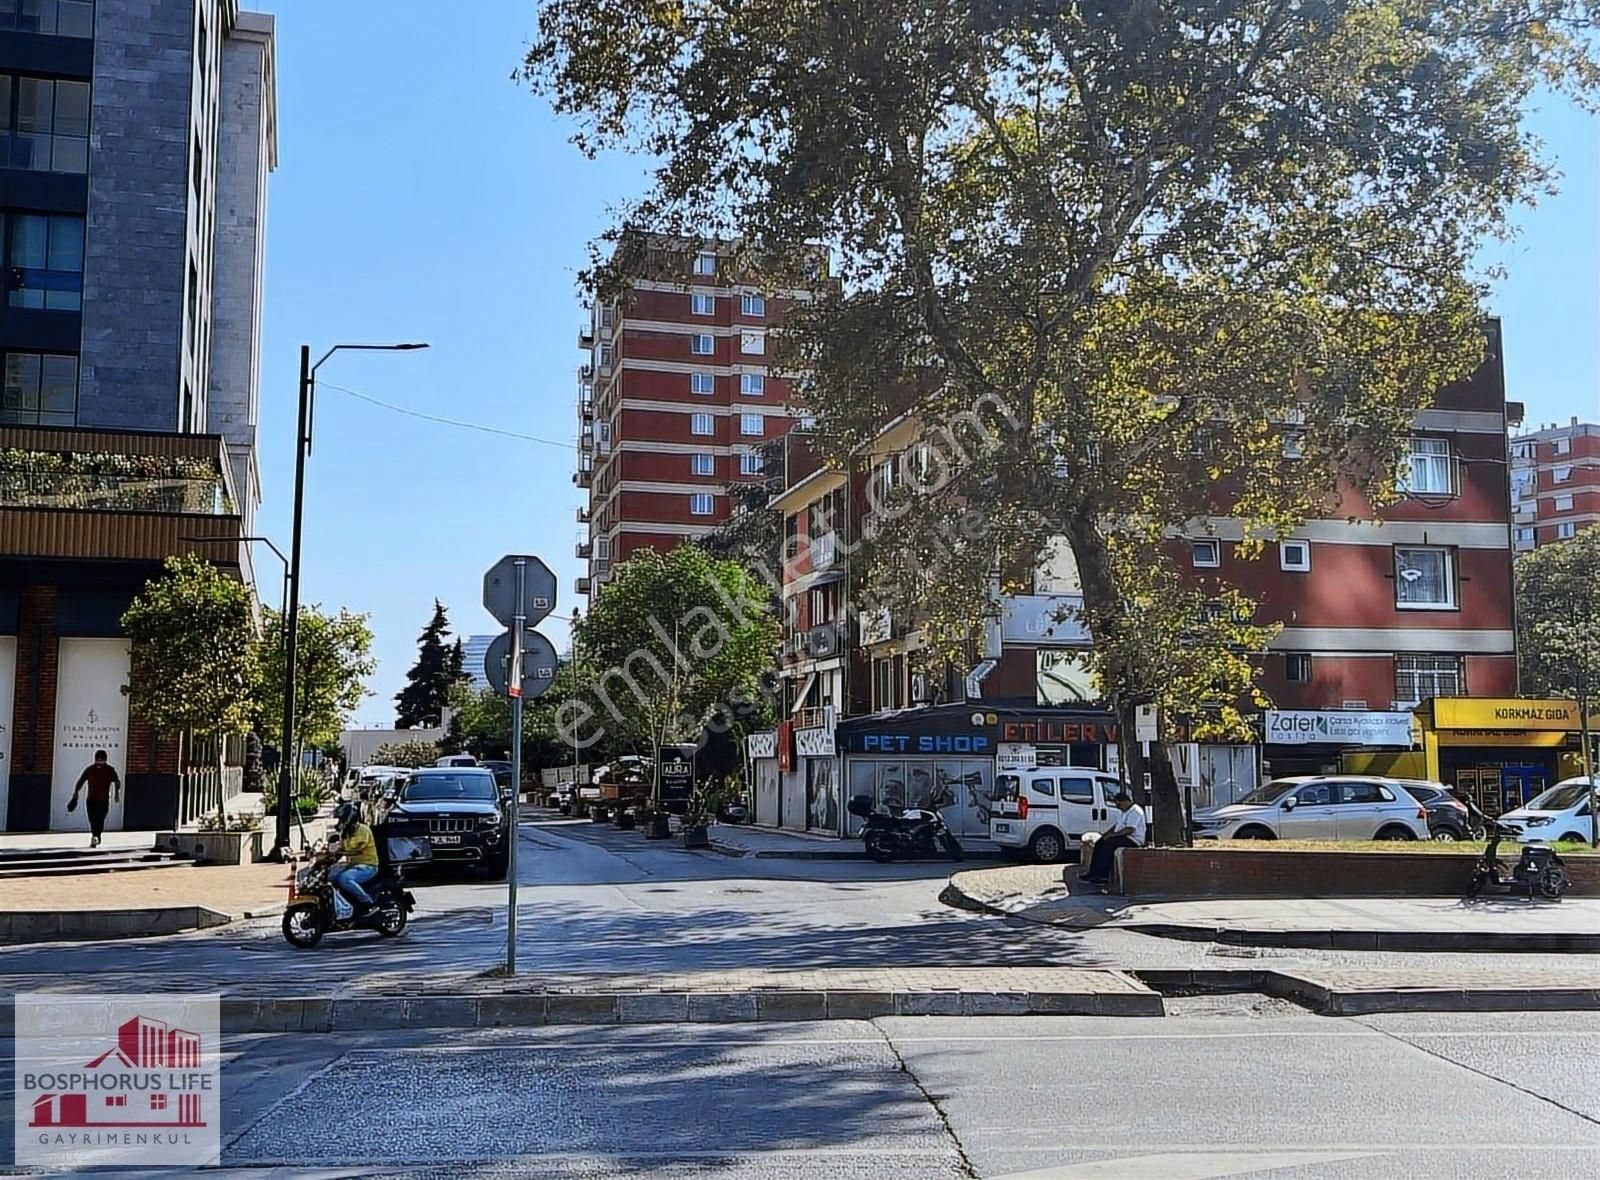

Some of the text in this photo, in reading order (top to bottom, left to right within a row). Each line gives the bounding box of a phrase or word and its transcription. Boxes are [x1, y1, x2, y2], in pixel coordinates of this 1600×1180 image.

[1495, 707, 1544, 720] KORKMAZ
[1271, 713, 1316, 732] Zafer
[864, 735, 988, 750] PET SHOP
